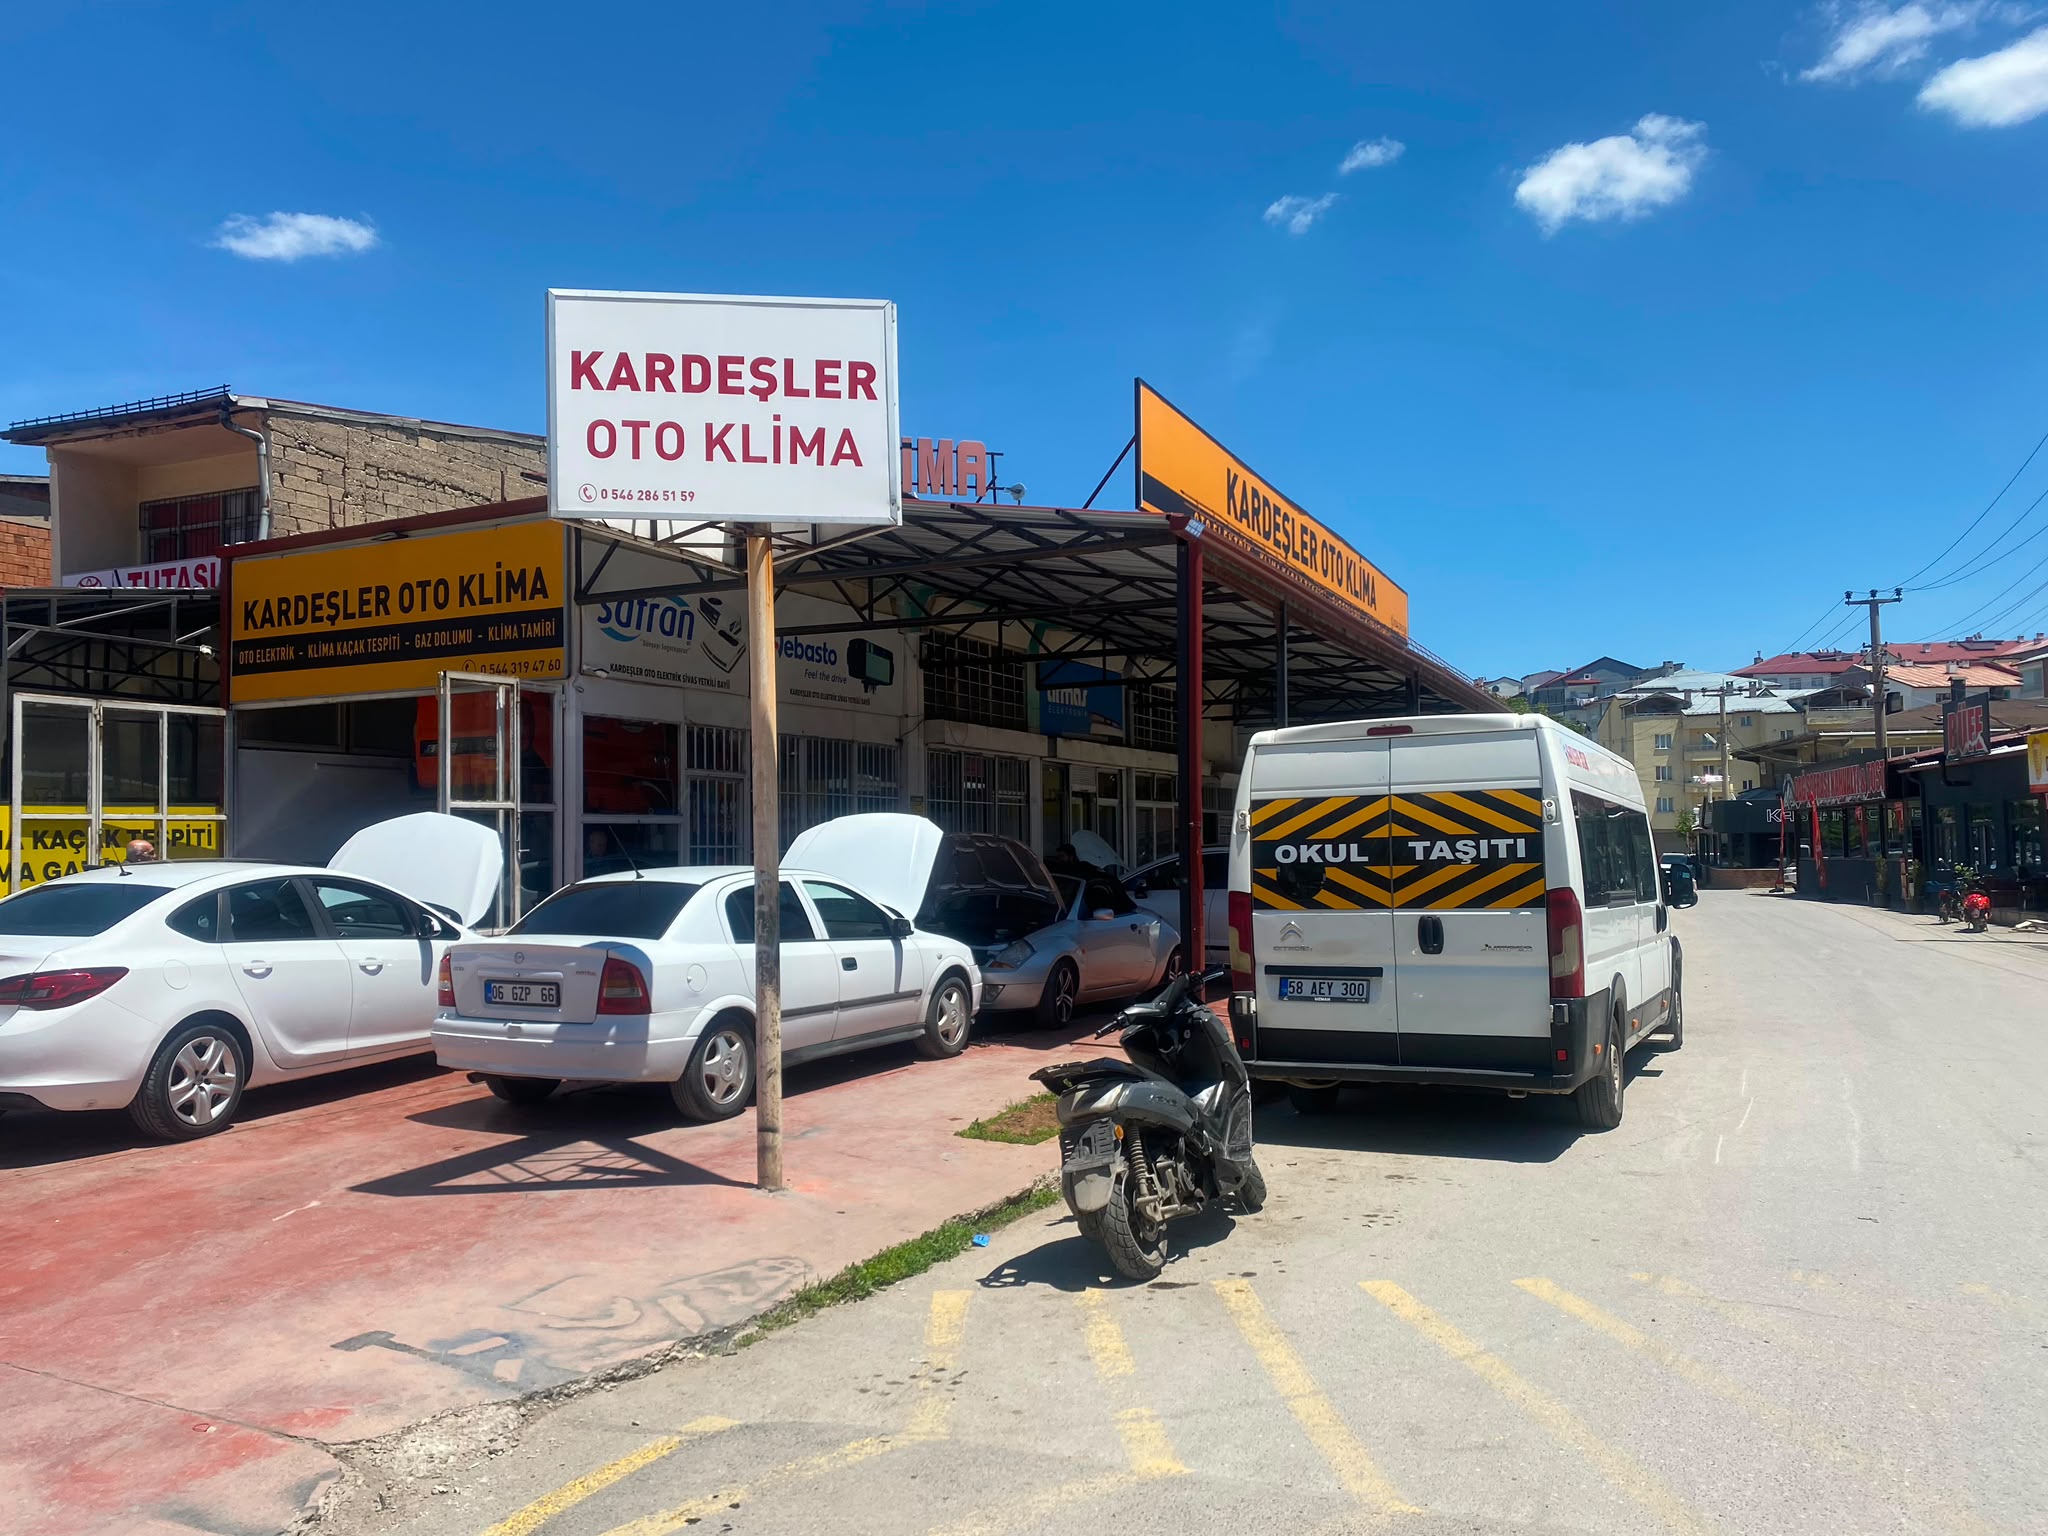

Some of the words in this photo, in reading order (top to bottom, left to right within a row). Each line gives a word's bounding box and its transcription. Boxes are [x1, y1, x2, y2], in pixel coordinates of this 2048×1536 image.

[570, 350, 878, 402] KARDEŞLER
[586, 418, 685, 461] OTO
[704, 413, 863, 468] KLİMA
[600, 488, 608, 500] 0
[611, 489, 634, 501] 546
[637, 489, 659, 501] 286
[662, 490, 676, 502] 51
[680, 490, 695, 502] 59
[1226, 466, 1318, 573] KARDEŞLER
[1321, 538, 1343, 588] OTO
[1345, 555, 1377, 612] KLİMA
[243, 584, 391, 632] KARDEŞLER
[398, 577, 450, 615] OTO
[458, 561, 549, 608] KLİMA
[239, 651, 254, 666] OTO
[255, 643, 295, 664] ELEKTRİK
[307, 641, 335, 659] KLİMA
[336, 638, 365, 657] KAÇAK
[366, 632, 401, 653] TESPİTİ
[414, 635, 433, 649] GAZ
[434, 630, 473, 648] DOLUMU
[487, 621, 521, 643] KLİMA
[523, 617, 556, 640] TAMİRİ
[489, 663, 508, 675] 544
[511, 661, 530, 674] 319
[532, 660, 545, 673] 47
[548, 658, 561, 671] 60
[609, 663, 644, 678] KARDEŞLER
[644, 668, 656, 679] OTO
[656, 669, 682, 683] ELEKTRİK
[804, 669, 818, 680] Feel
[819, 671, 830, 682] the
[831, 674, 848, 685] drive
[32, 829, 120, 855] KAÇK
[1273, 843, 1369, 864] OKUL
[1407, 838, 1527, 865] TAŞITI
[491, 985, 504, 1000] 06
[511, 986, 531, 1002] GZP
[540, 987, 555, 1002] 66
[1288, 981, 1304, 995] 58
[1310, 981, 1334, 996] AEY
[1341, 982, 1365, 997] 300
